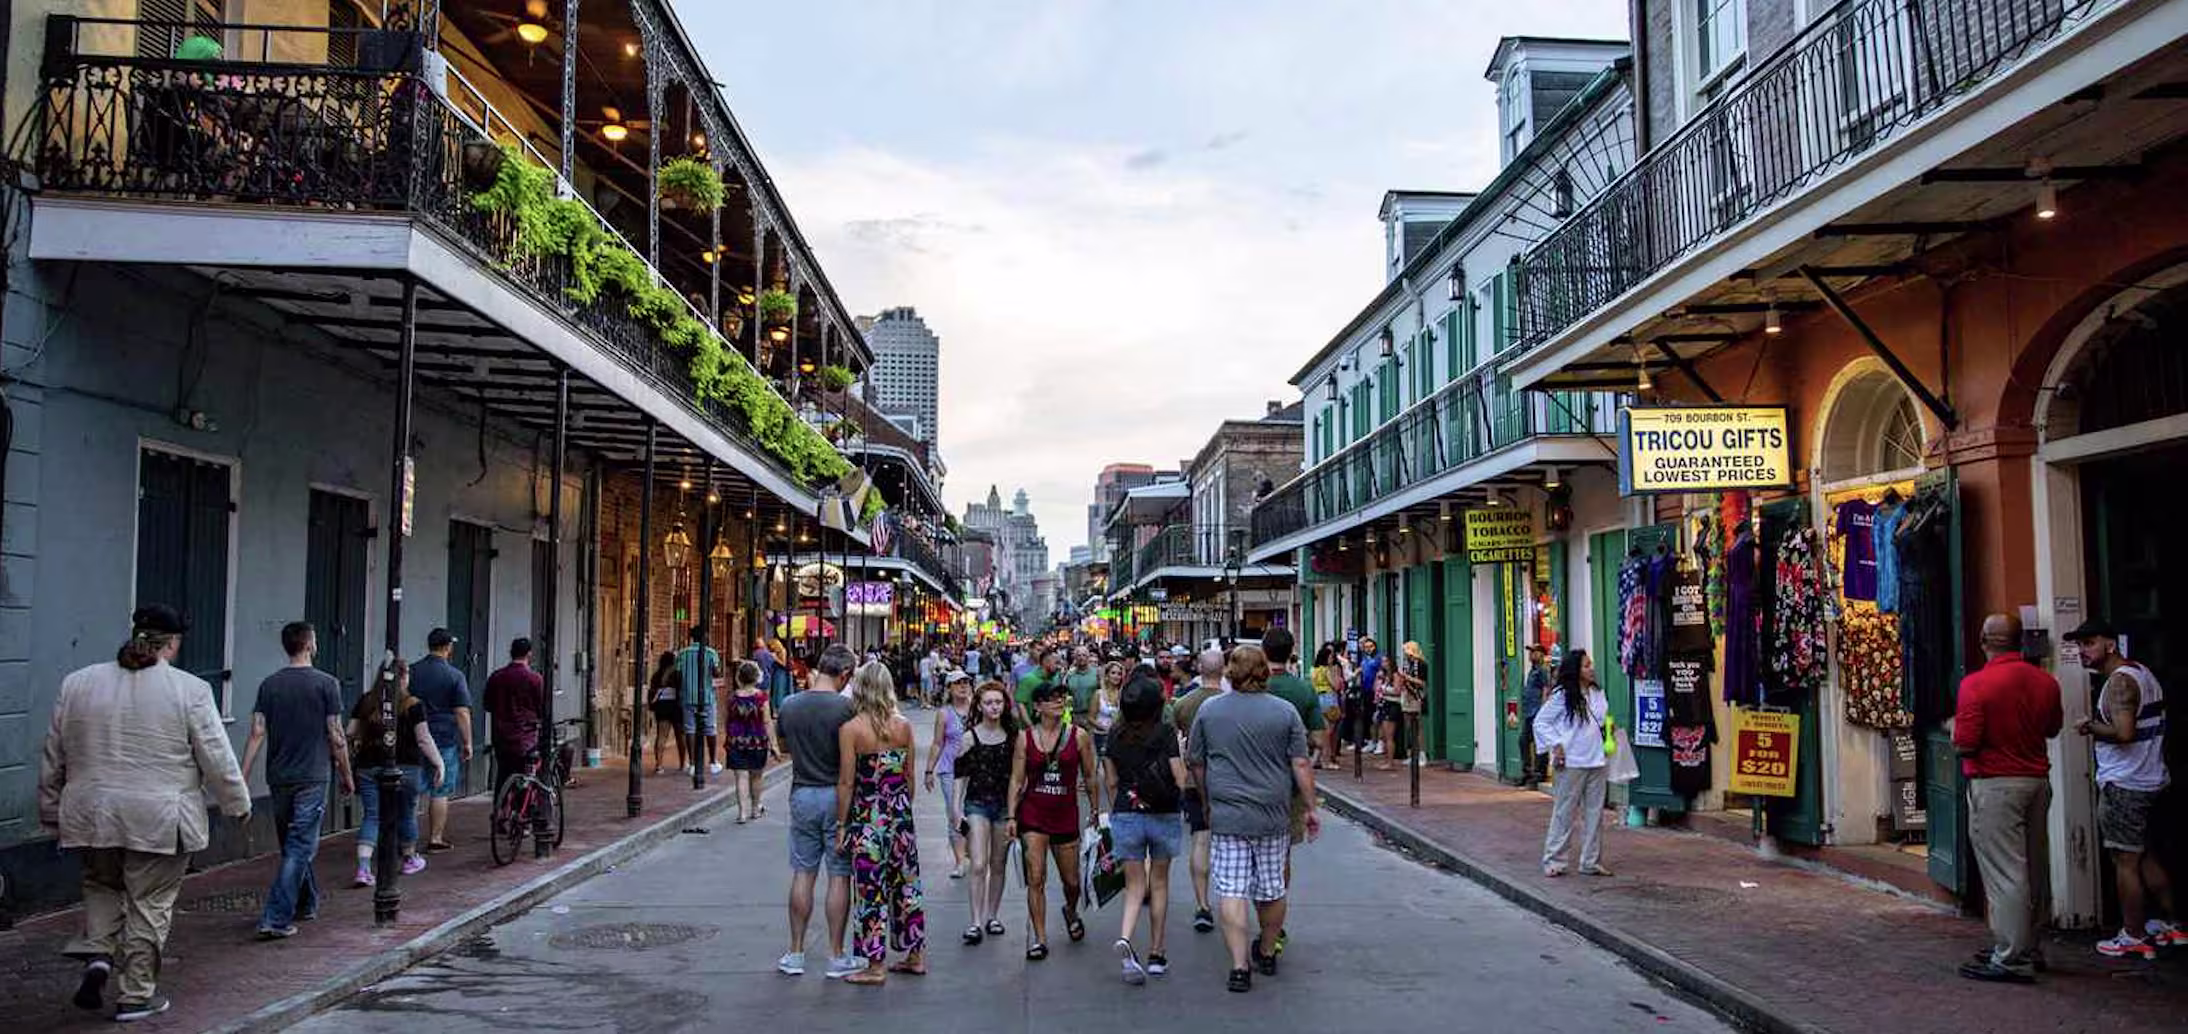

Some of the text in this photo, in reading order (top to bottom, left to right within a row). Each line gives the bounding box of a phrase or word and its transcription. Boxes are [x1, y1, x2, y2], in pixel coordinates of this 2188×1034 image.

[1664, 413, 1751, 423] 709 BOURBON ST.
[1635, 428, 1782, 451] TRICOU GIFTS
[1655, 456, 1764, 469] GUARANTEED
[1644, 468, 1776, 483] LOWEST PRICES
[1469, 512, 1532, 523] BOURBON
[1472, 525, 1531, 537] TOBACCO
[1470, 548, 1534, 562] CIGARETTES
[1680, 585, 1700, 595] GOT
[1648, 697, 1658, 712] 5
[1757, 732, 1773, 748] 5
[1748, 749, 1780, 759] FOR
[1741, 759, 1786, 776] $20
